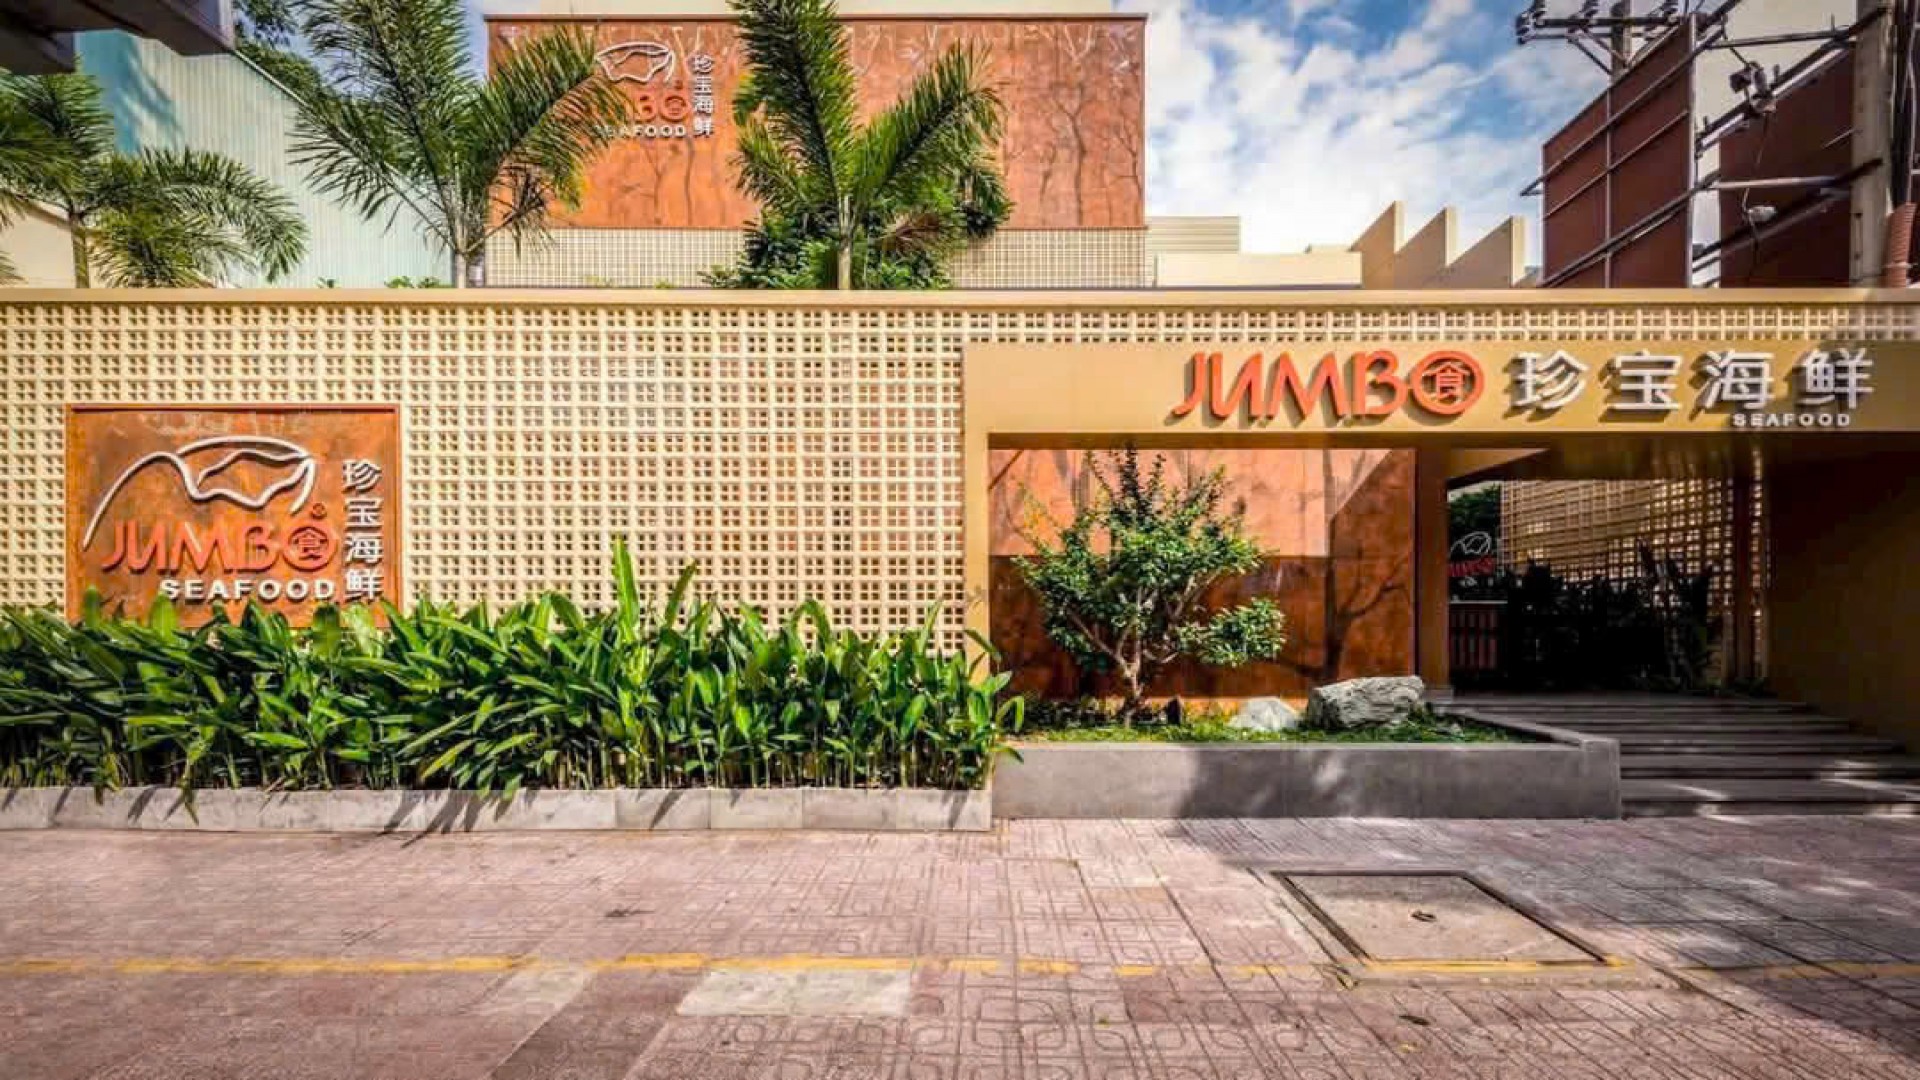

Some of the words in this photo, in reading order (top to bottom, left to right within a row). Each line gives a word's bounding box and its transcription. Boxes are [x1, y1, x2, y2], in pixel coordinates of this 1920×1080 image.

[1171, 350, 1485, 417] JUMBO
[1510, 349, 1874, 409] 珍宝海鲜
[1733, 413, 1851, 427] SEAFOOD
[101, 519, 337, 572] JUMBO
[343, 458, 384, 600] 珍宝海鲜
[160, 578, 335, 601] SEAFOOD
